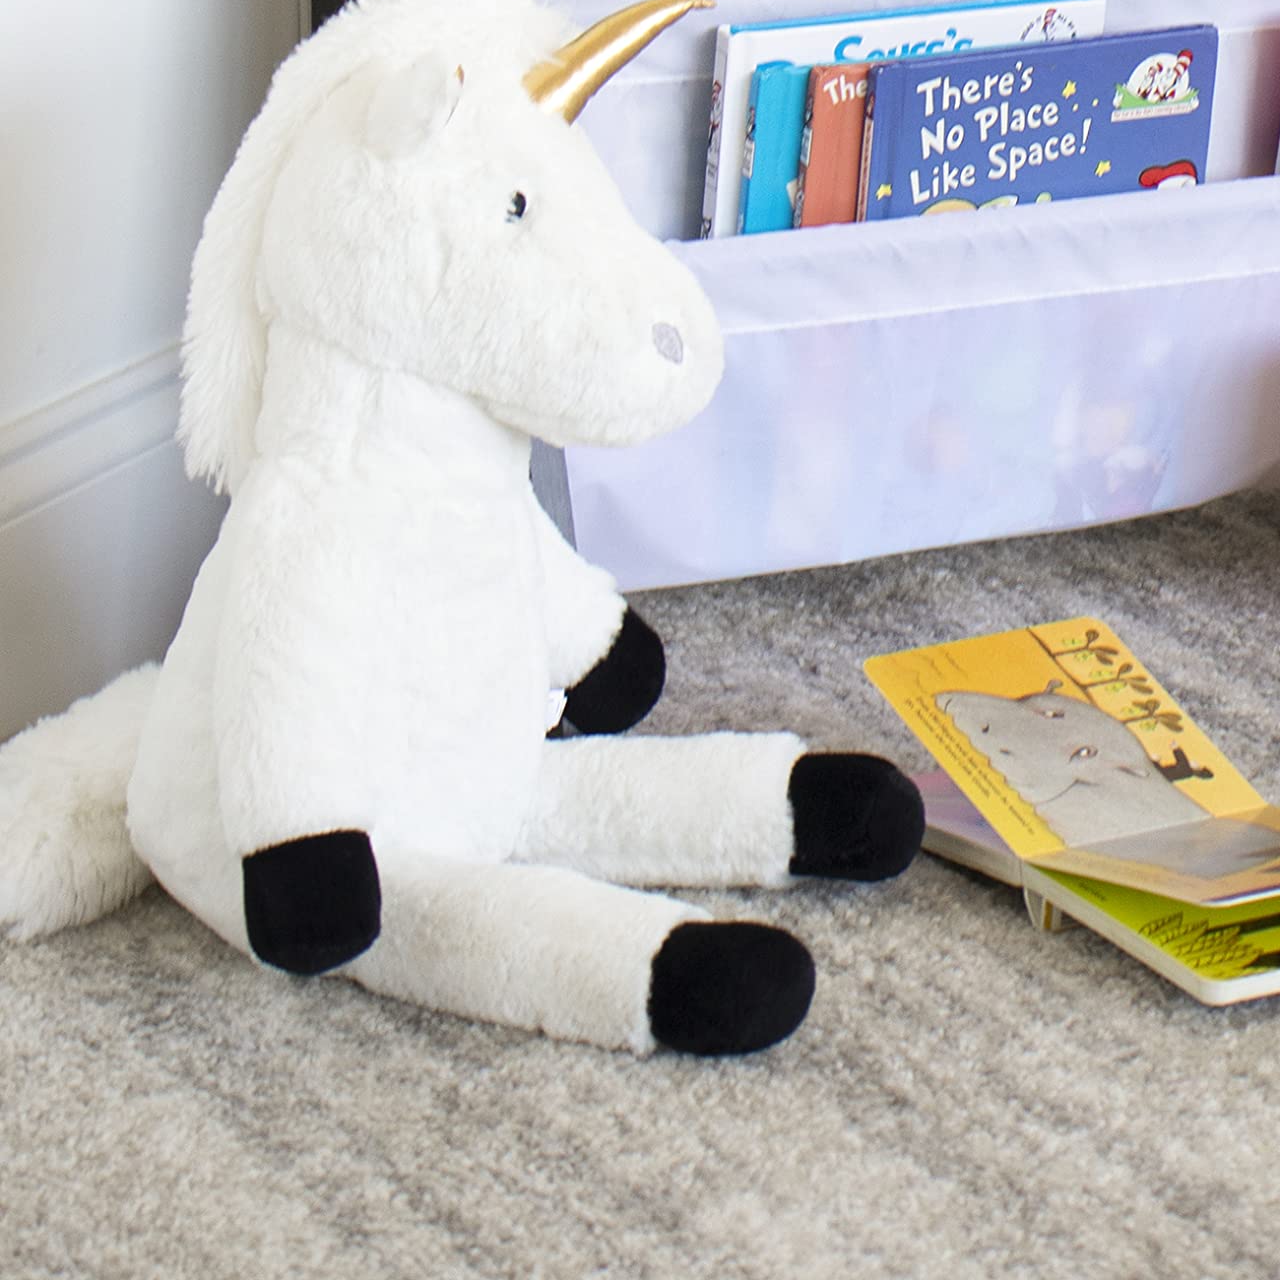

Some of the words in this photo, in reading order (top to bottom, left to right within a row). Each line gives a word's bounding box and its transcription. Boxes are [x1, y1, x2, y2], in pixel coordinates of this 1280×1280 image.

[823, 74, 867, 106] The
[916, 60, 1034, 117] There's
[921, 118, 964, 160] No
[974, 101, 1059, 142] Place
[910, 161, 976, 205] Like
[987, 117, 1092, 182] Space!
